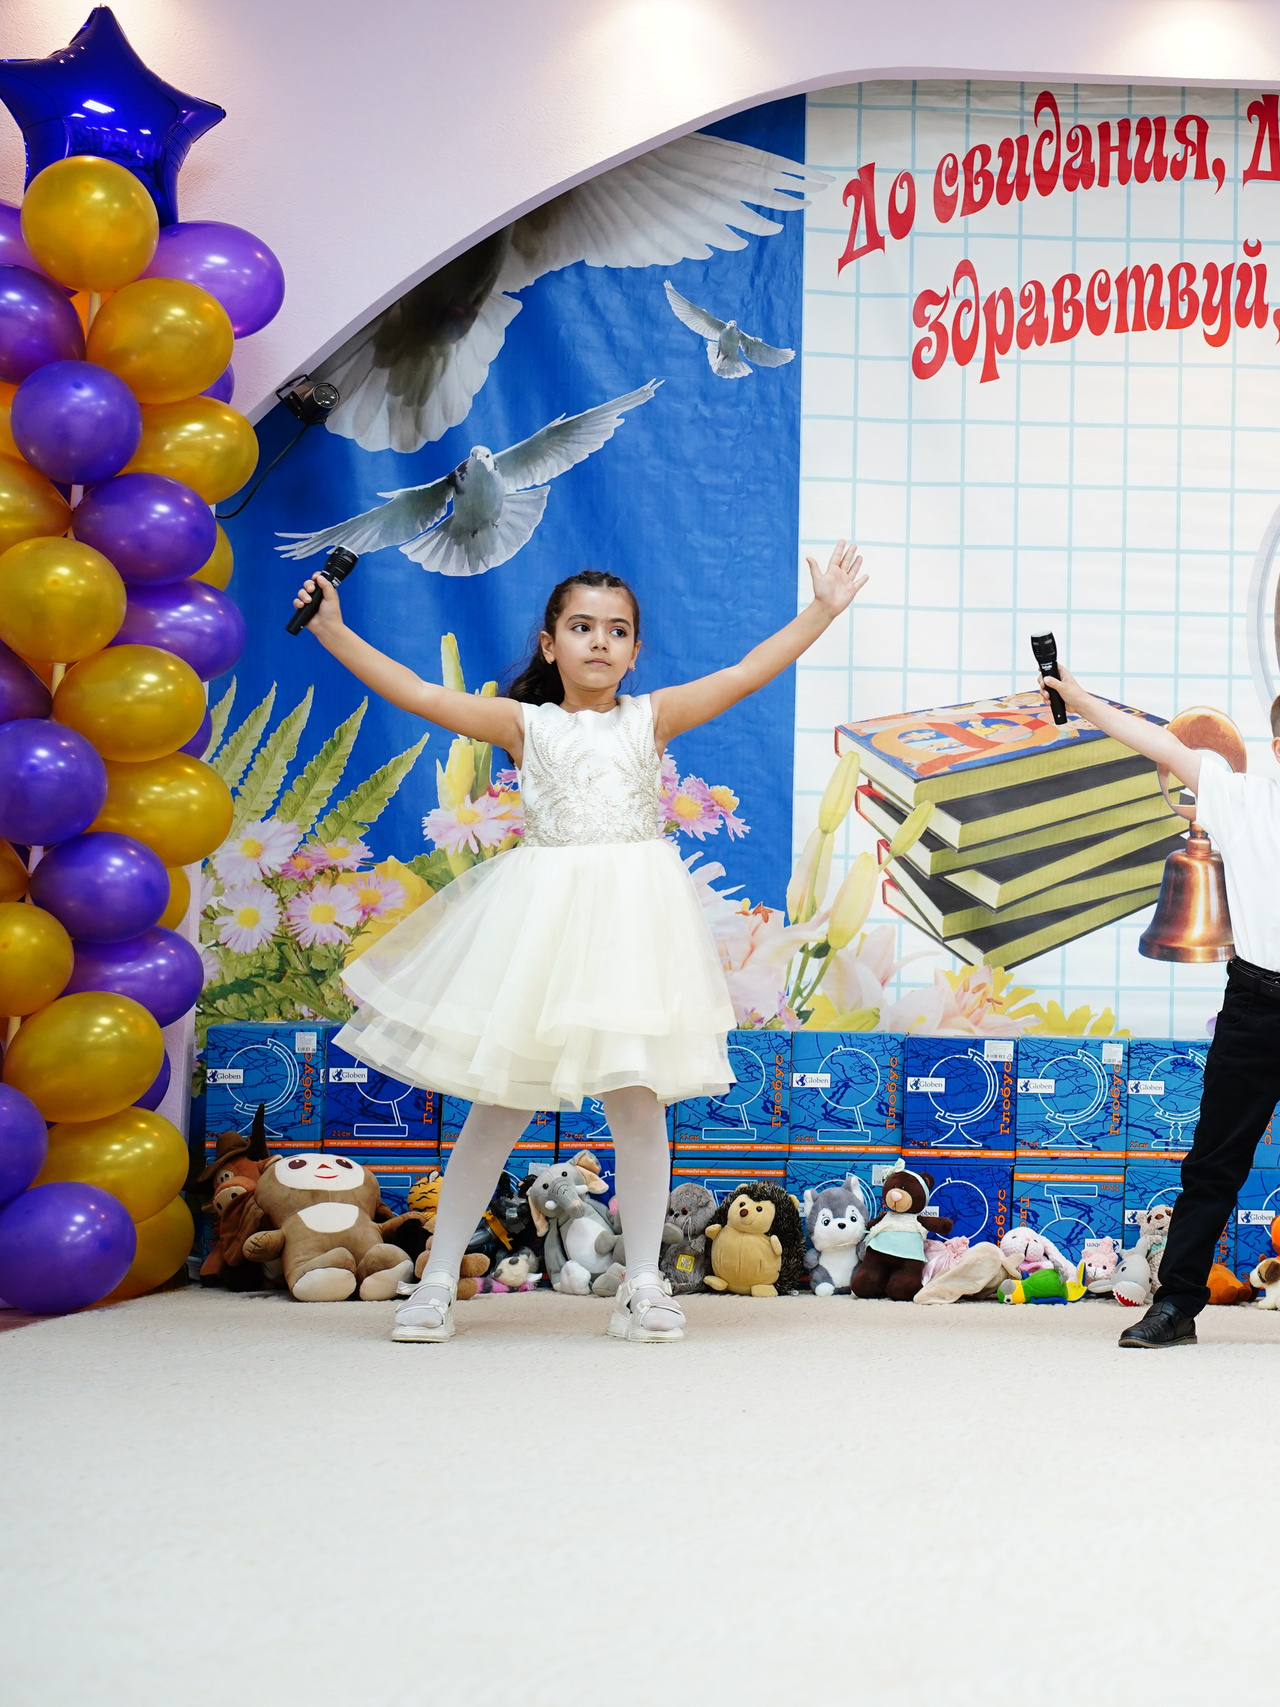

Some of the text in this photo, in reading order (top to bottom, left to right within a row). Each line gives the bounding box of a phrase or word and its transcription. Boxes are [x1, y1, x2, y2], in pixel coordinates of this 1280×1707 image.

[837, 161, 916, 275] До
[933, 90, 1226, 224] свидания,
[216, 1072, 242, 1081] Globen
[341, 1071, 366, 1079] Globen
[804, 1076, 829, 1084] Globen
[919, 1080, 943, 1088] Globen
[770, 1054, 785, 1128] Глобус
[1139, 1083, 1163, 1091] Globen
[885, 1056, 899, 1130] Глобус
[1000, 1061, 1013, 1135] Глобус
